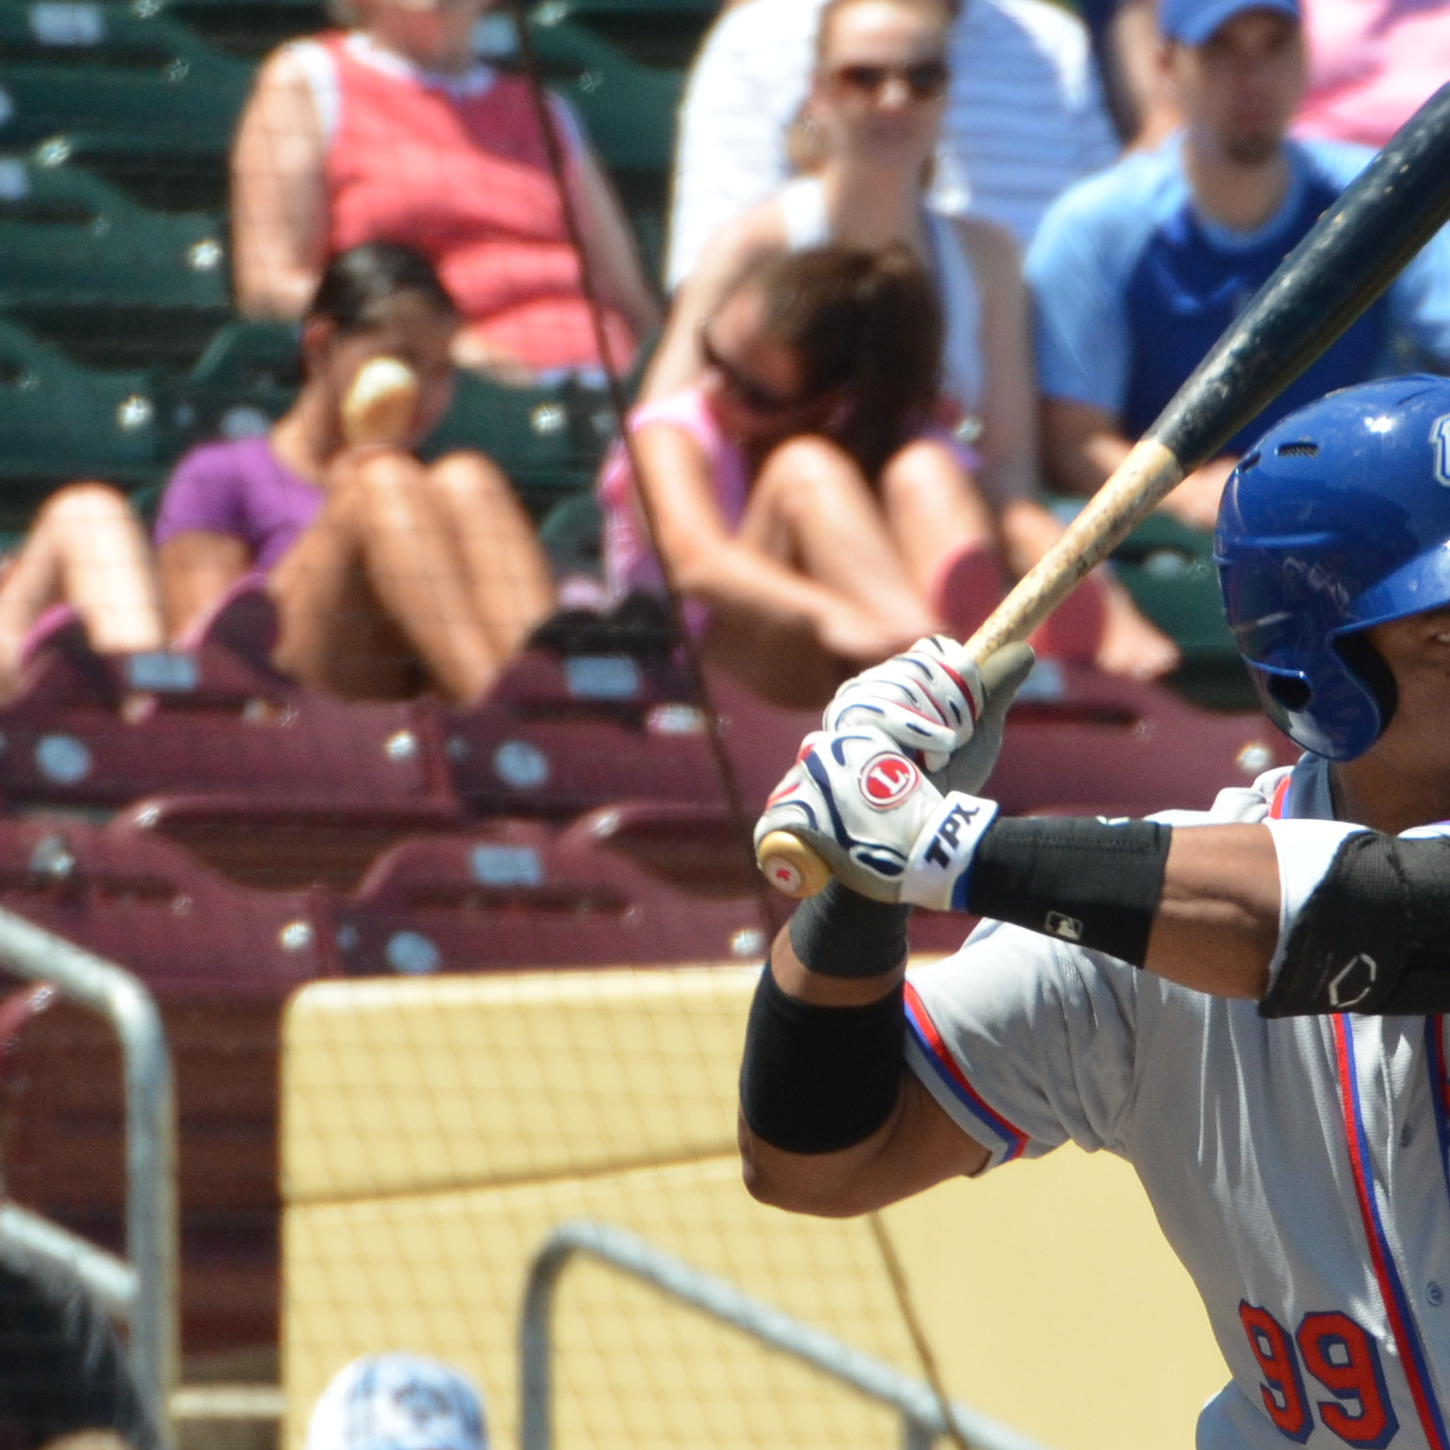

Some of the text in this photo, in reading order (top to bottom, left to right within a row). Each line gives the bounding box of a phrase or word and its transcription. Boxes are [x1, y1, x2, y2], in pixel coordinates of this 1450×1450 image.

[868, 765, 910, 796] L
[924, 803, 981, 870] TPX
[1238, 1299, 1400, 1450] 99
